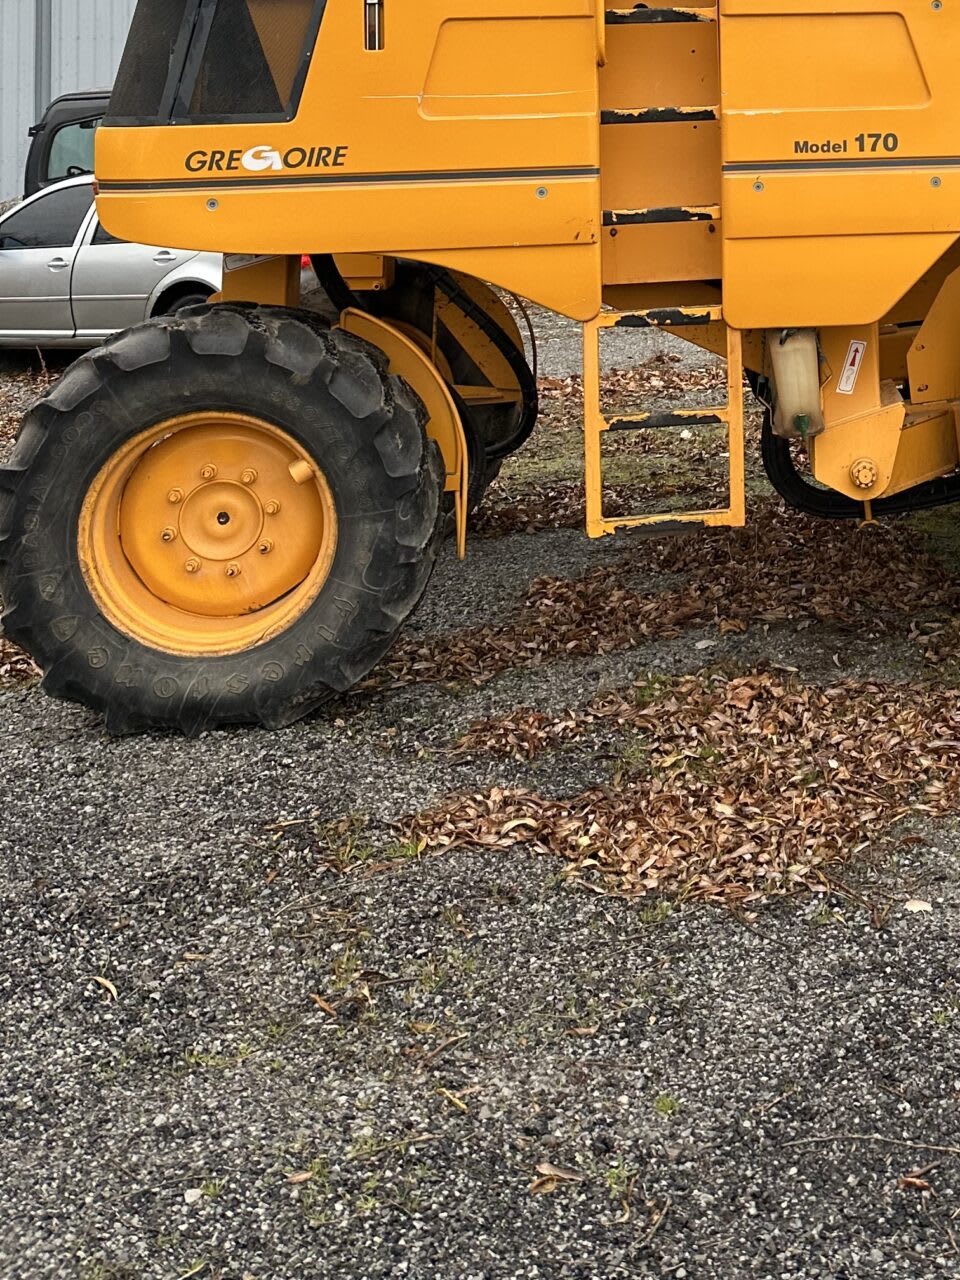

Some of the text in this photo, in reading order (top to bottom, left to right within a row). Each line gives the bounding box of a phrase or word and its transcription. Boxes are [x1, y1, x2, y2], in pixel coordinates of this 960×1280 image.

[794, 133, 898, 153] Model 170
[184, 145, 349, 172] GREGOIRE
